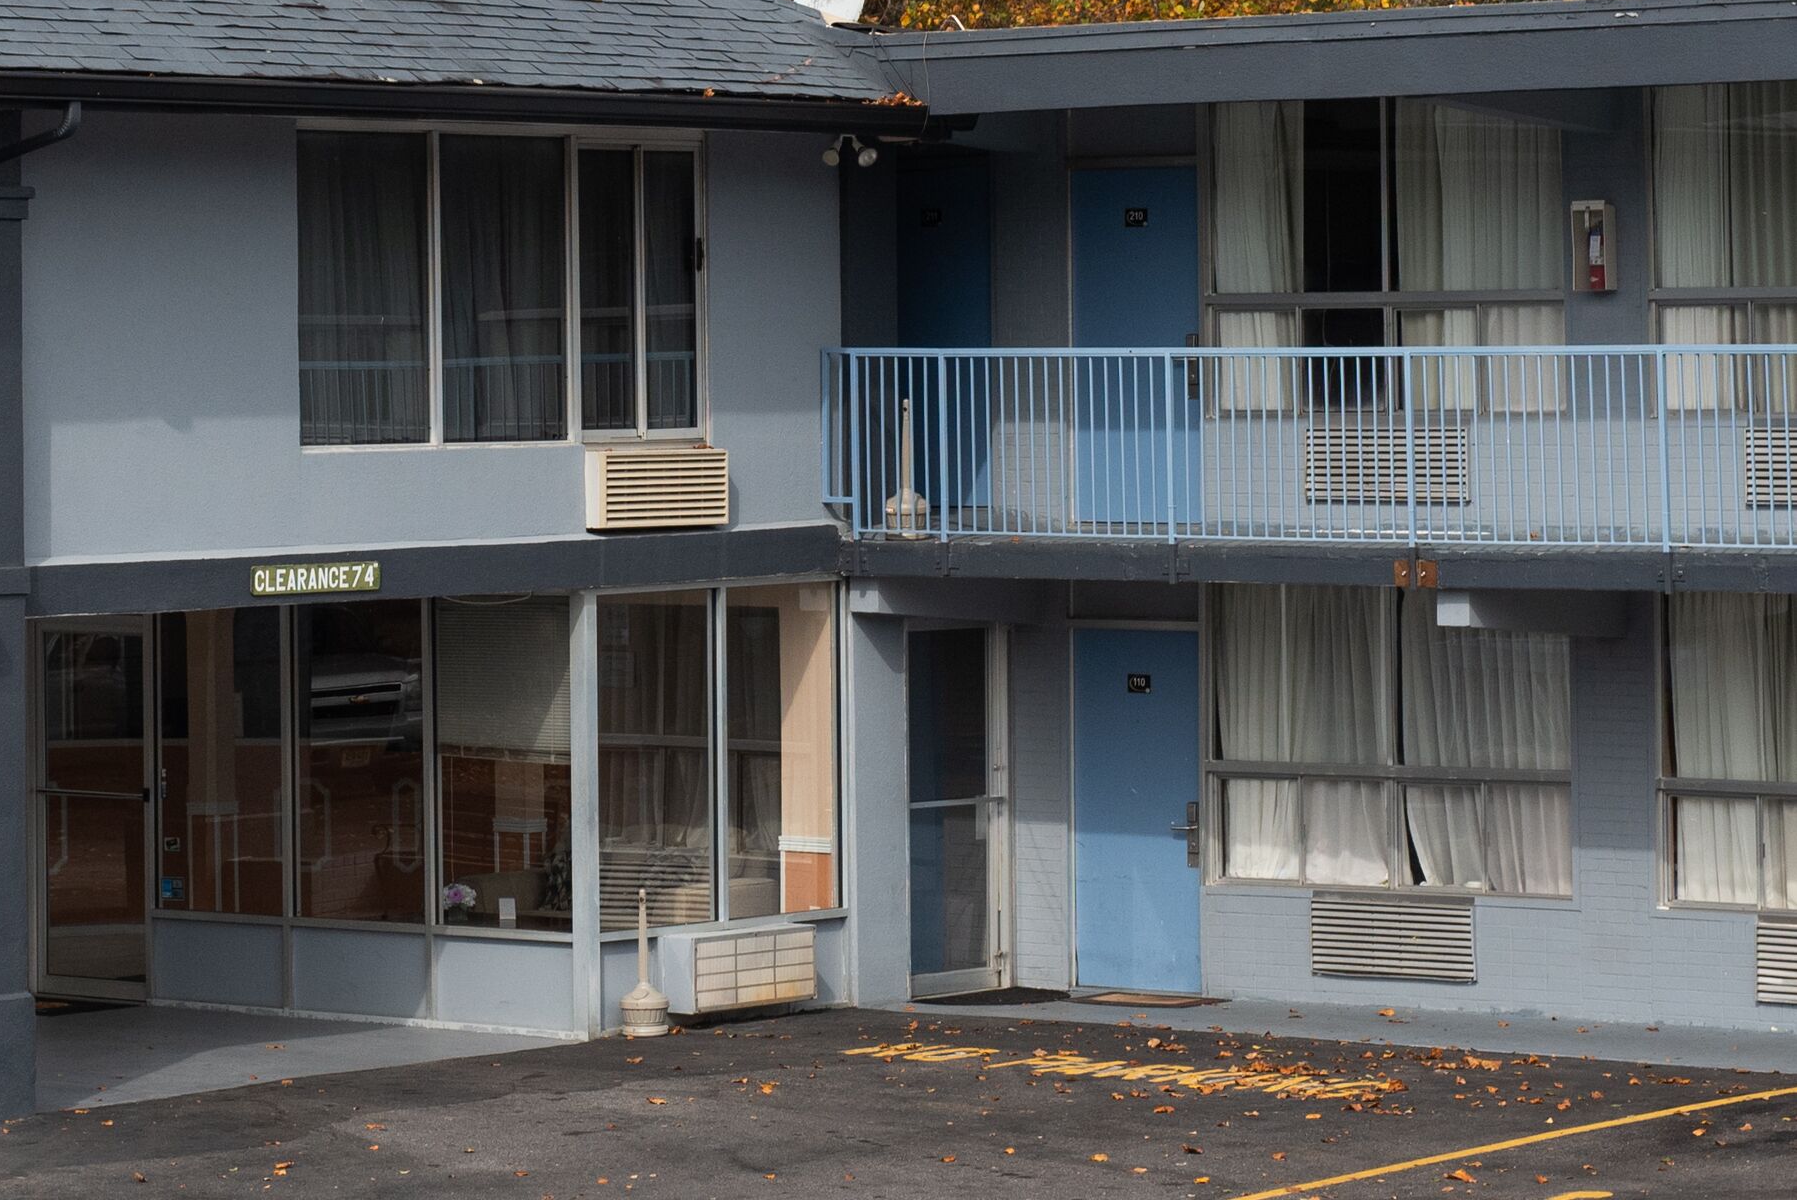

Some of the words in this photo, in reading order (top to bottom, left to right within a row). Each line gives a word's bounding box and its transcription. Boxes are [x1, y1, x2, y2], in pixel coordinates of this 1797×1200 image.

[1129, 211, 1144, 221] 210
[254, 566, 350, 593] CLEARANCE
[1133, 677, 1146, 687] 110
[841, 1042, 1000, 1062] NO
[982, 1054, 1386, 1100] PARKING
